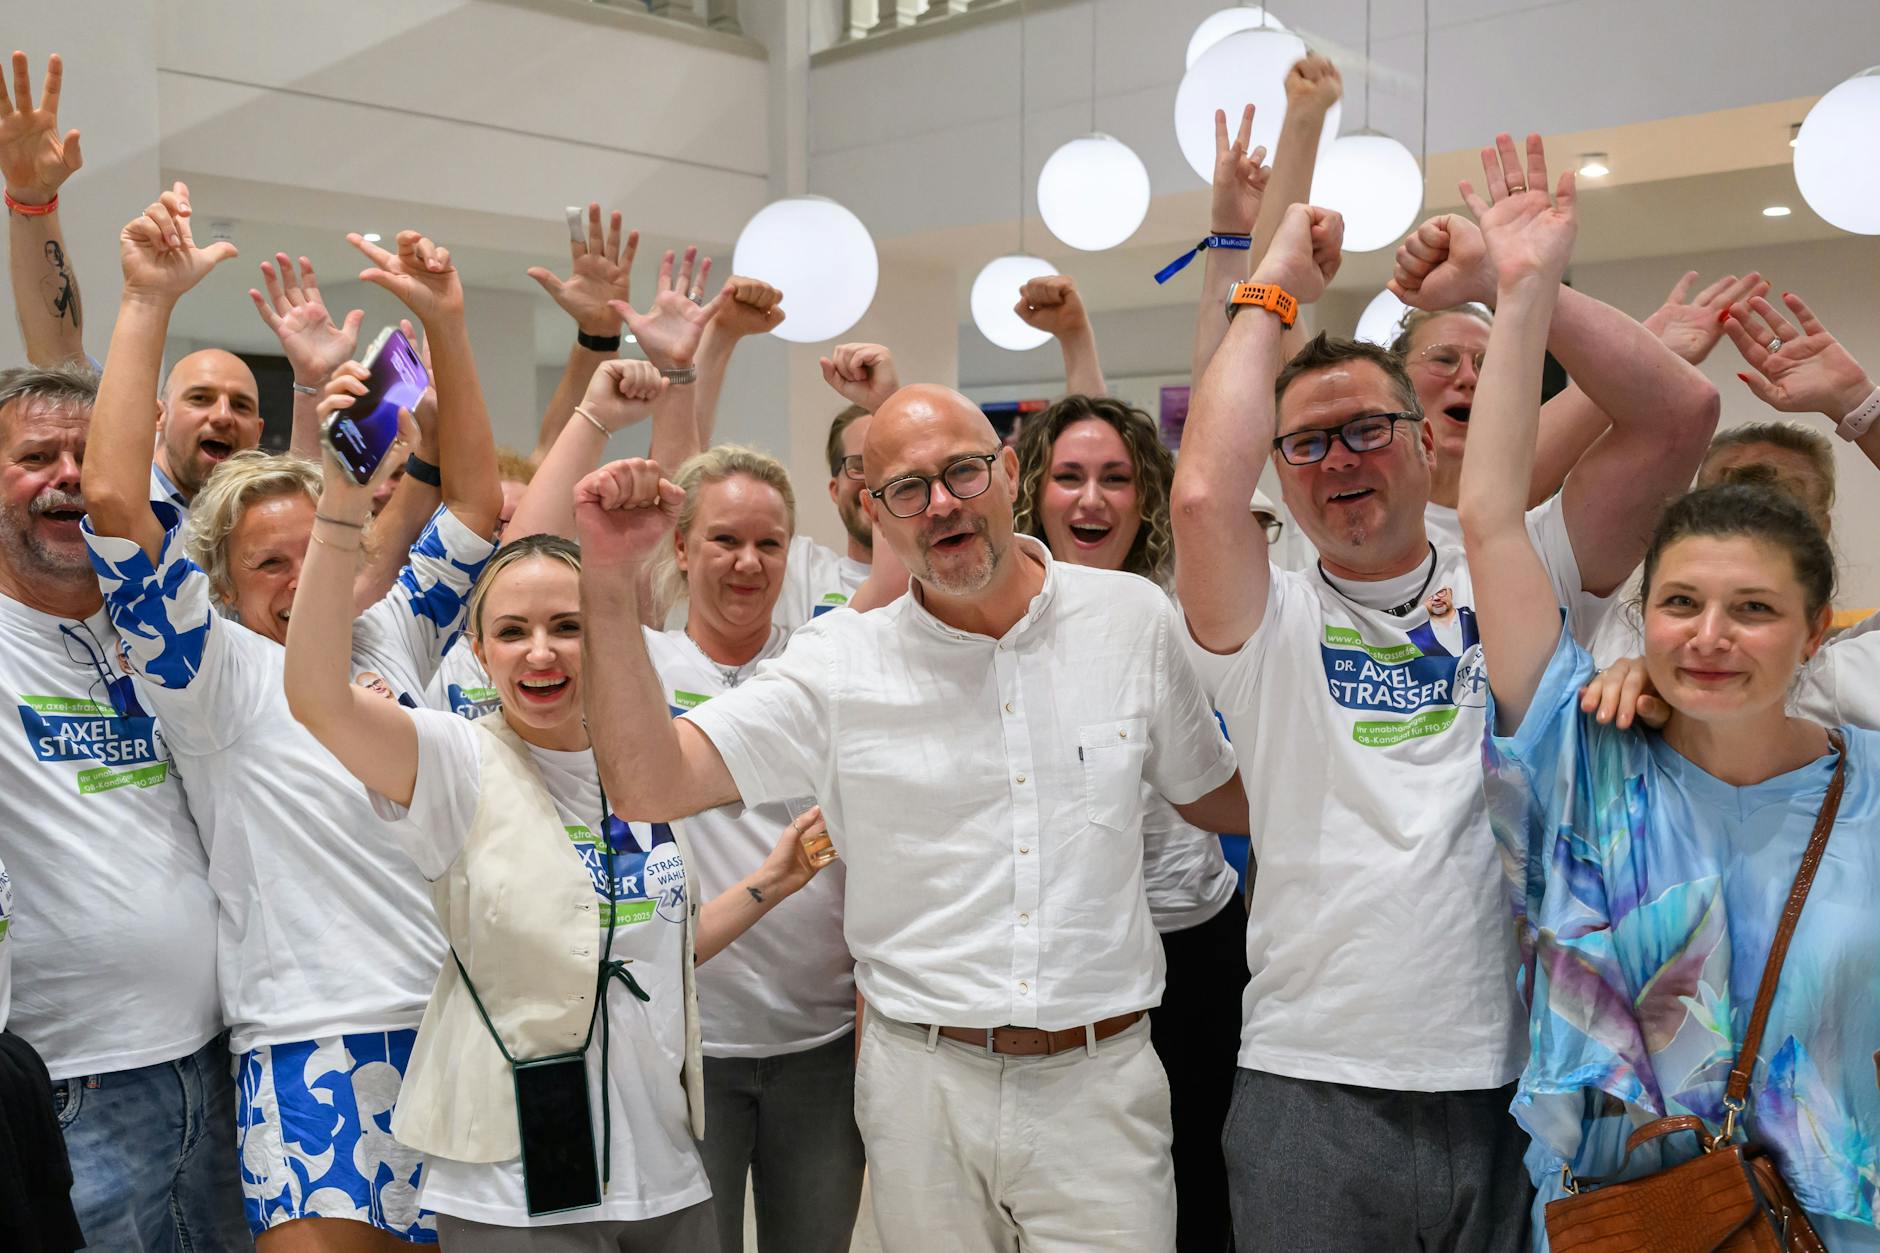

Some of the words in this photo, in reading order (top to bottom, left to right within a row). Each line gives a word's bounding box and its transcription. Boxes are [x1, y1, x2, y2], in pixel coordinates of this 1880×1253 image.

[1335, 659, 1356, 672] DR.
[1359, 660, 1419, 688] AXEL
[1329, 679, 1449, 709] STRASSER
[59, 720, 119, 742] AXEL
